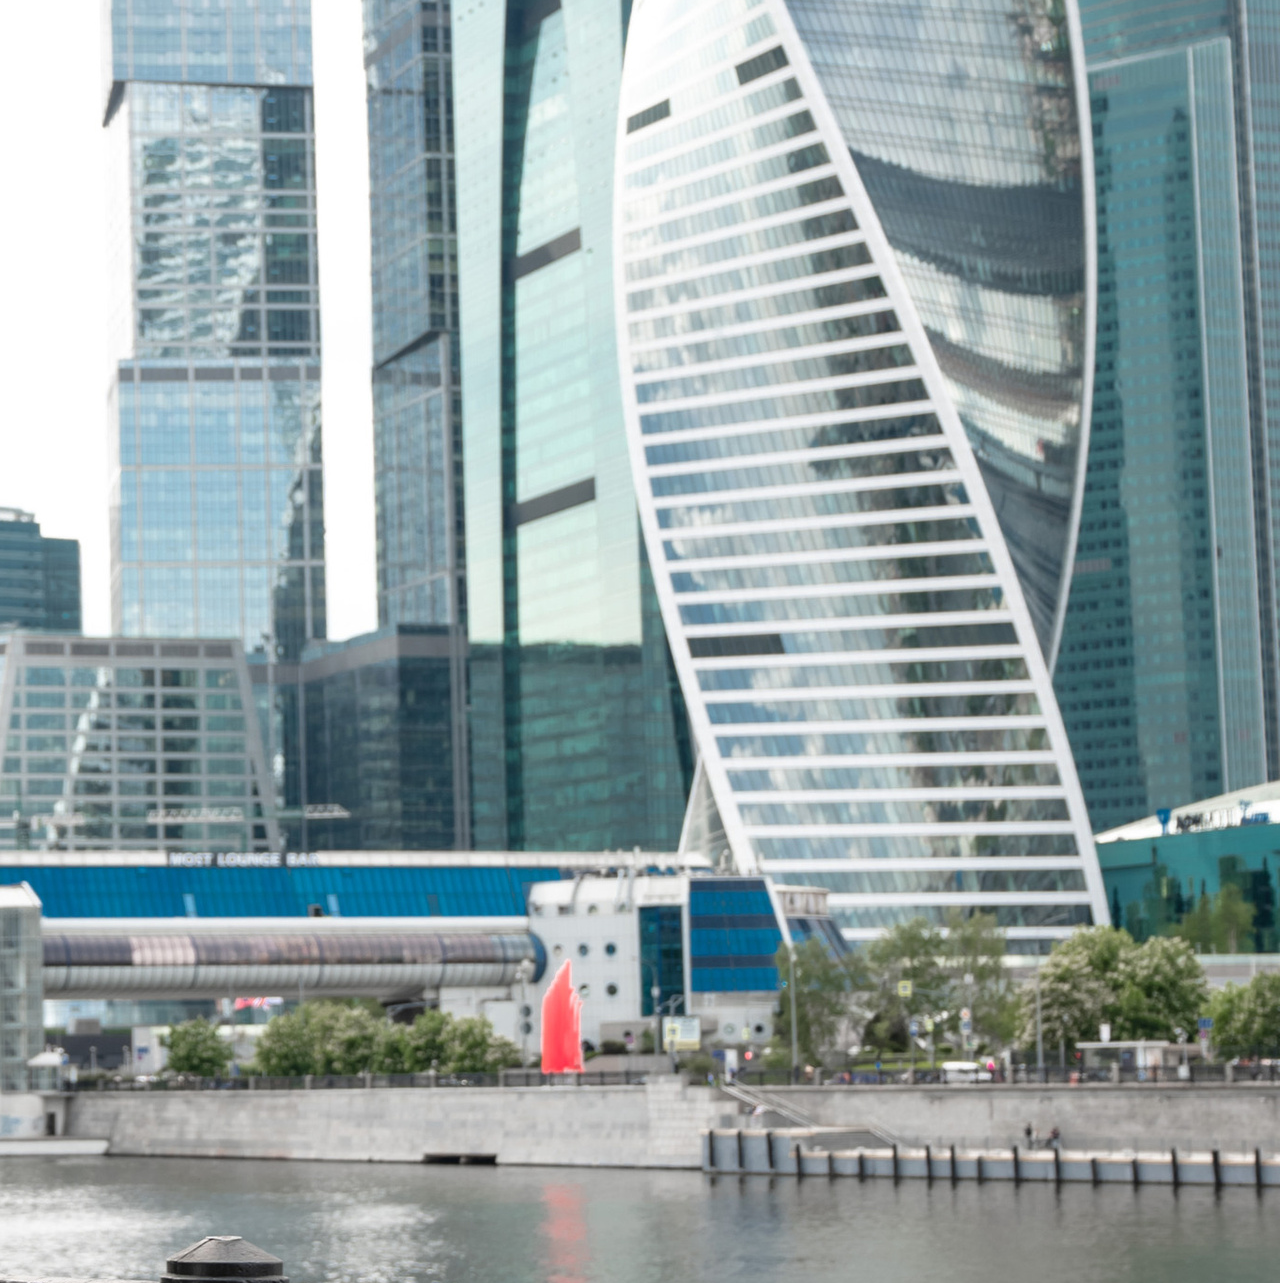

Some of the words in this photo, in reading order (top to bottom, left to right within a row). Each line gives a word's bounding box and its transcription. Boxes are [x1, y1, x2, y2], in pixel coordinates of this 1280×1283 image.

[169, 852, 214, 867] MOST
[217, 852, 281, 867] LOUNGE
[286, 852, 320, 867] BAR
